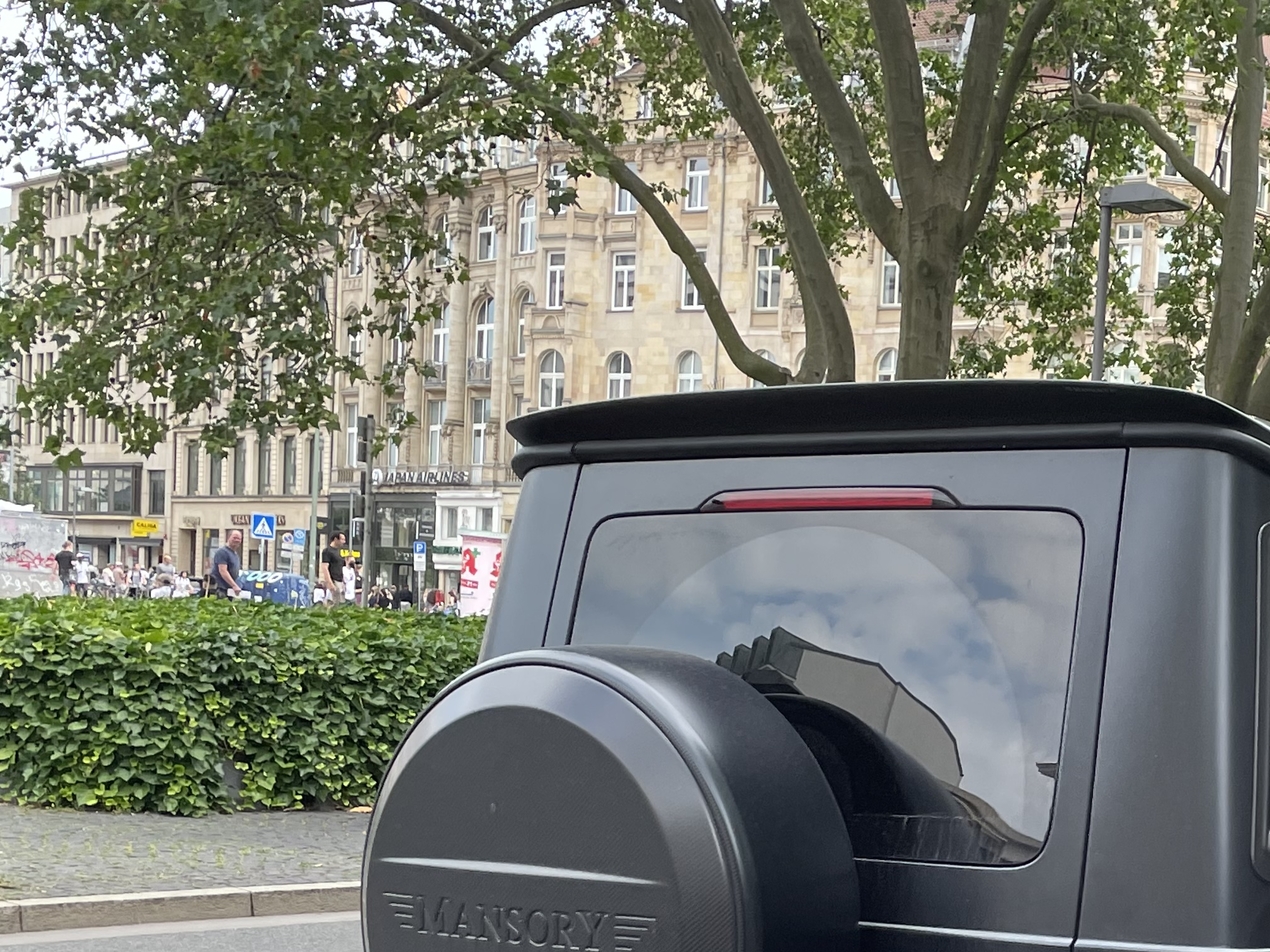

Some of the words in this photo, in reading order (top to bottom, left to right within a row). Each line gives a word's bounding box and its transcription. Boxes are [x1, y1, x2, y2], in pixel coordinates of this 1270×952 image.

[385, 471, 415, 484] JAPAN
[417, 471, 469, 484] AIRLINES
[416, 895, 609, 952] MANSORY
